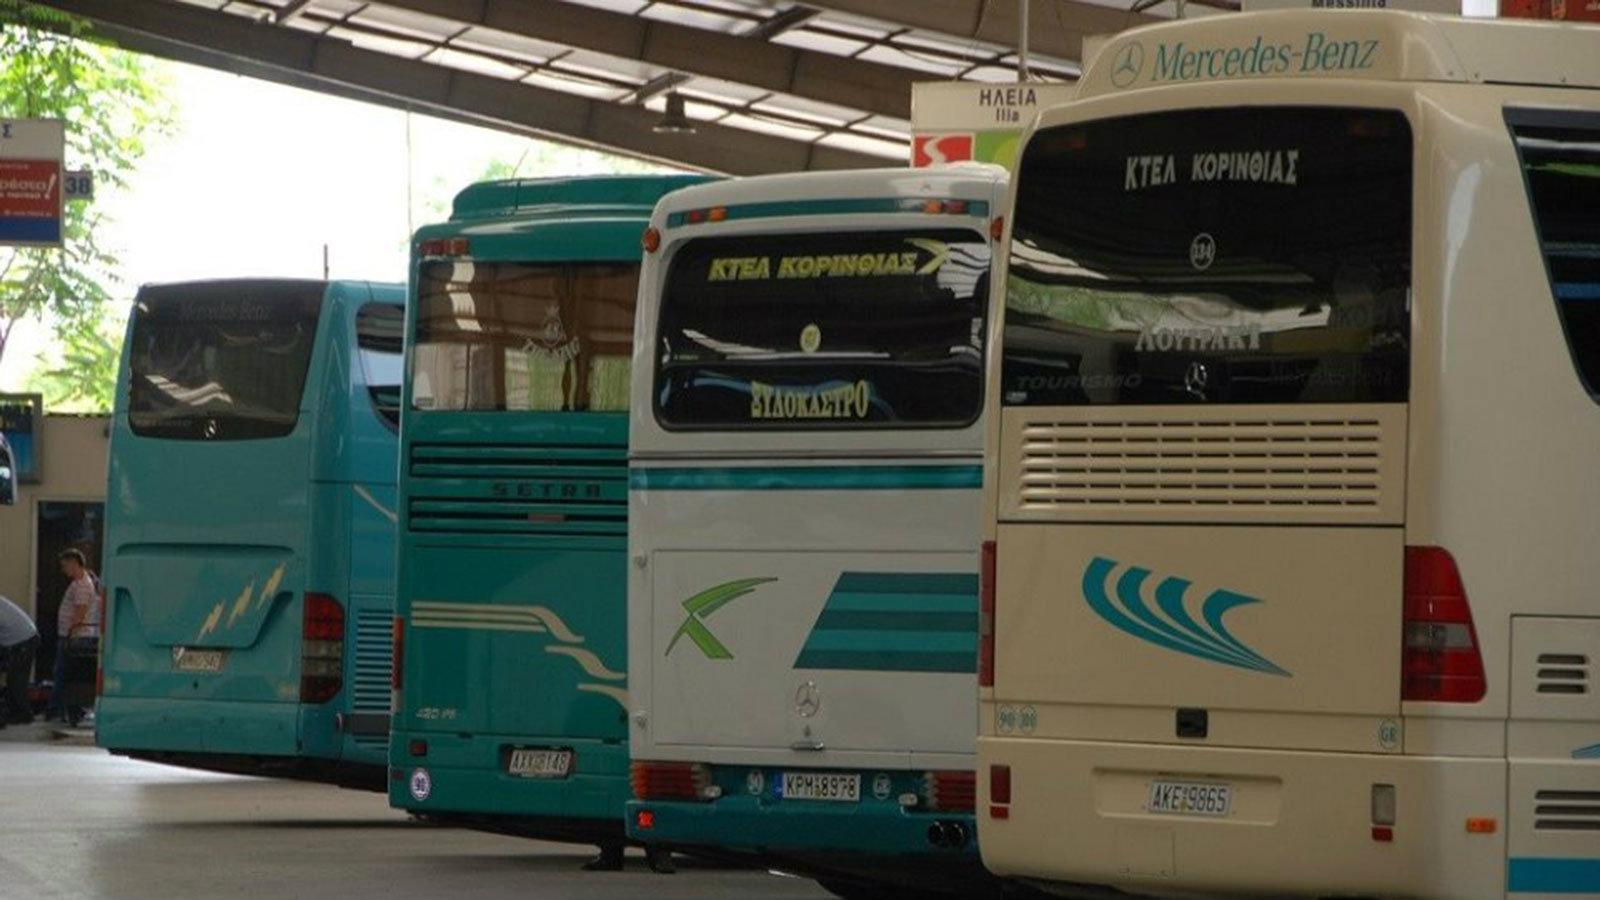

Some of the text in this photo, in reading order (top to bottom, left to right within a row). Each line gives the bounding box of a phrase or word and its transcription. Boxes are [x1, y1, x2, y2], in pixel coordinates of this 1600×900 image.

[1152, 32, 1380, 81] Mercedes-Benz
[979, 88, 1037, 106] ΗΛΕΙΑ
[1124, 150, 1299, 190] ΚΤΕΛ ΚΟΡΙΝΘΙΑΣ
[65, 176, 91, 195] 38
[707, 252, 918, 281] ΚΤΕΛ ΚΟΡΙΝΘΙΑΣ
[1016, 373, 1143, 390] TOURISMO
[492, 482, 601, 498] SETRA
